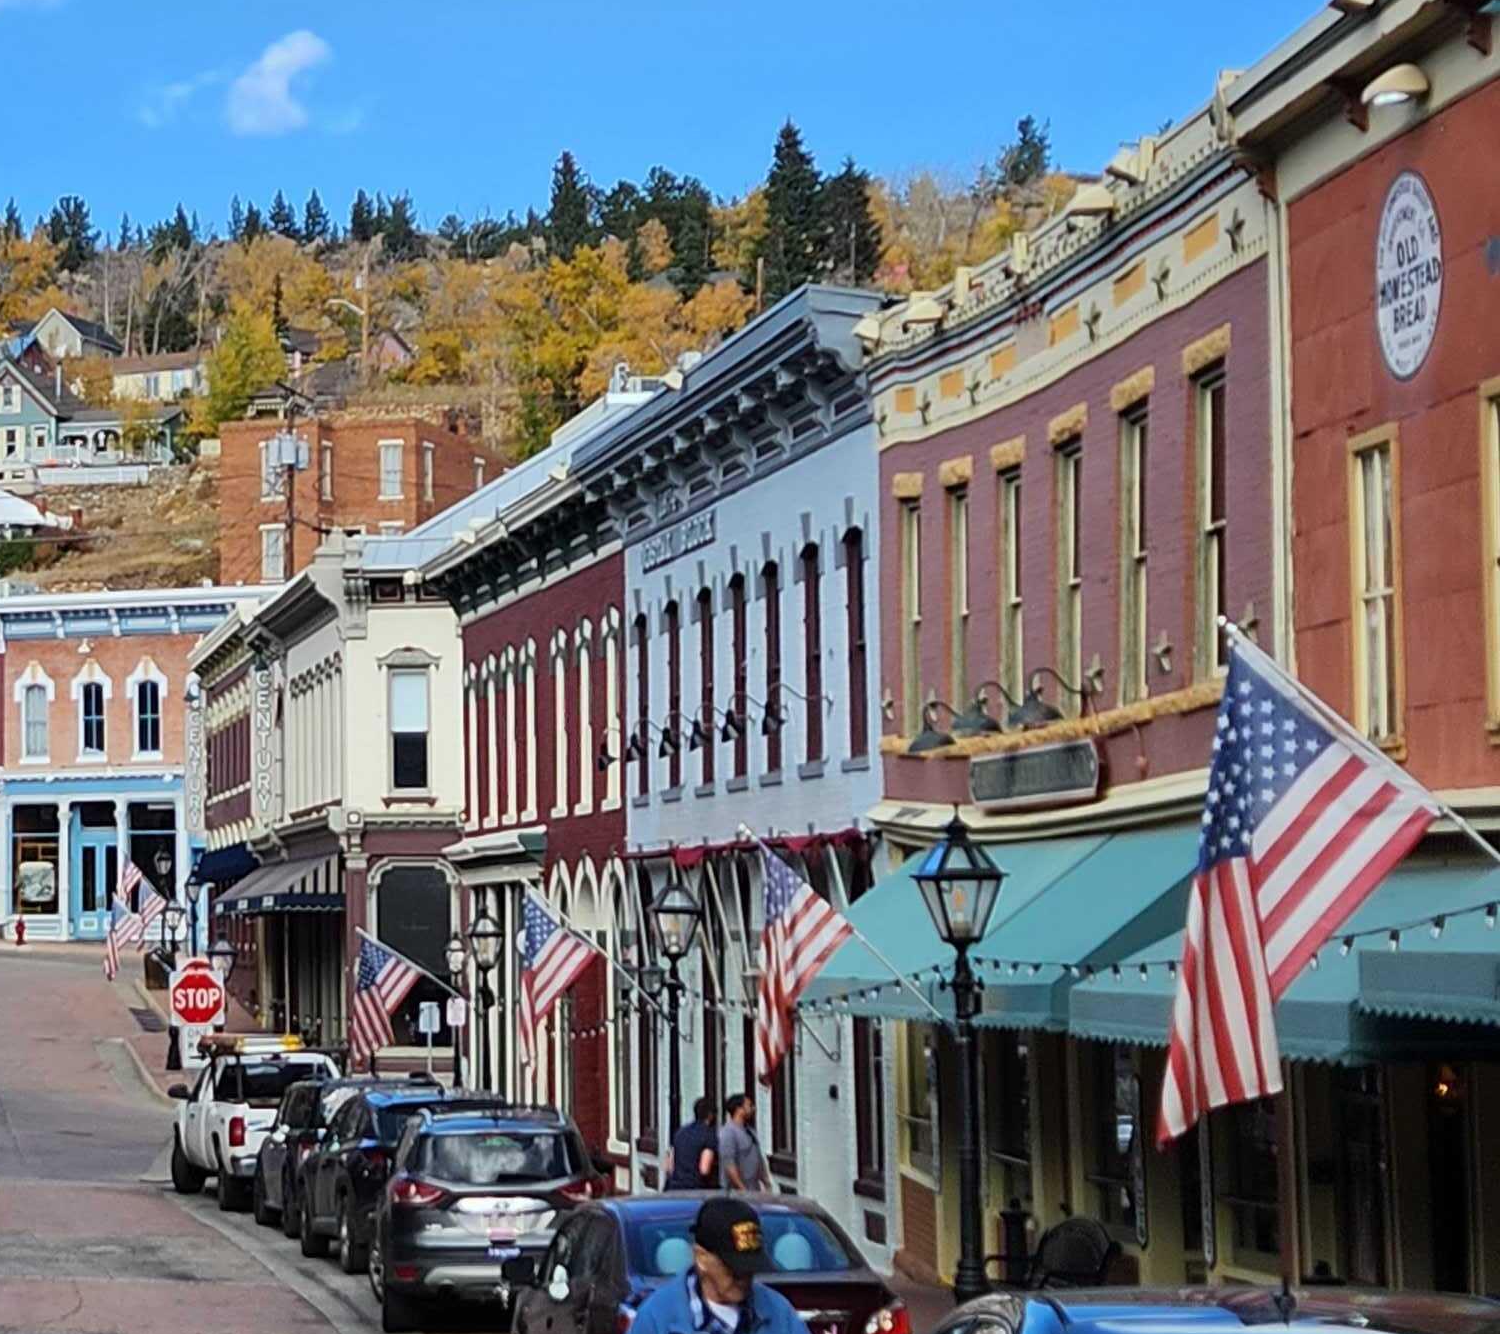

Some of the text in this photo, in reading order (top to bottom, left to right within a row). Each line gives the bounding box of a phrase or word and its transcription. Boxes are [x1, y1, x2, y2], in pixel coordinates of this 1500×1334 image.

[1395, 234, 1420, 268] OLD
[1379, 257, 1442, 309] HOMESTEAD
[1393, 295, 1429, 335] BREAD
[254, 669, 274, 812] CENTURY
[188, 712, 202, 828] CENTURY
[174, 987, 221, 1010] STOP
